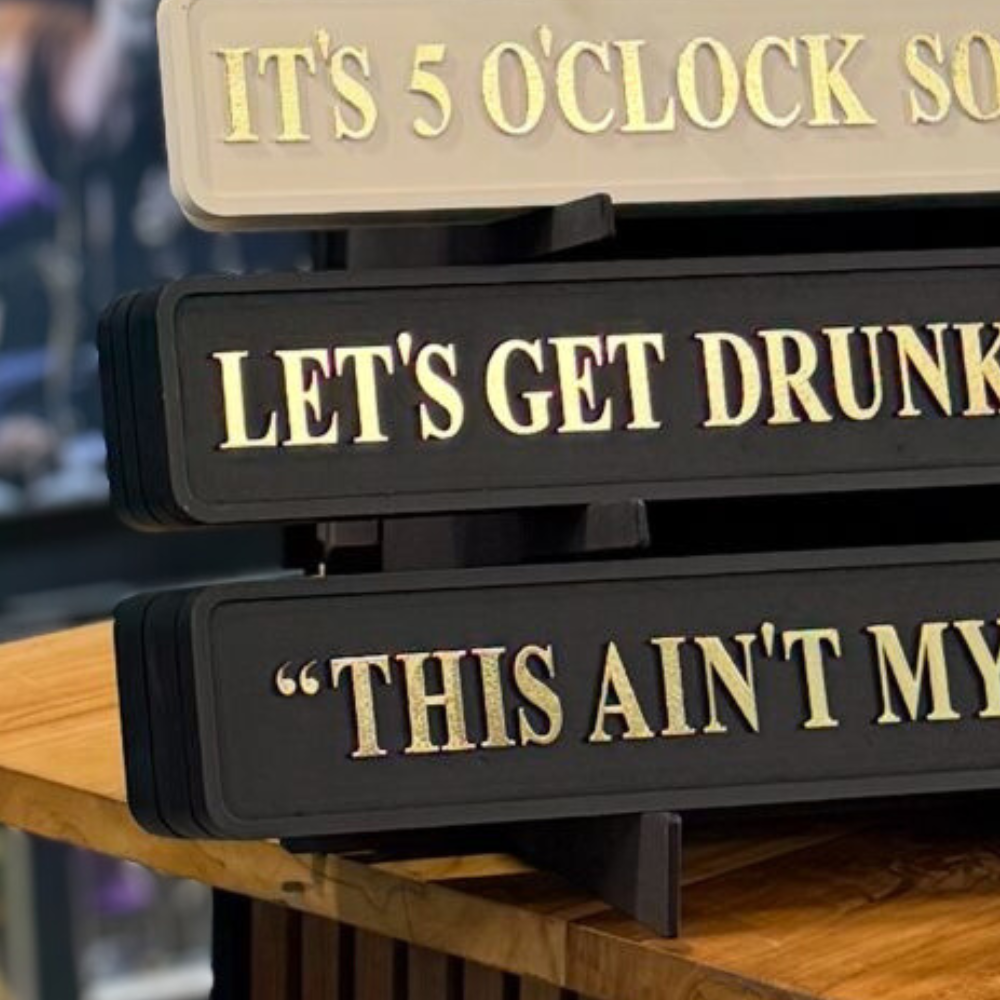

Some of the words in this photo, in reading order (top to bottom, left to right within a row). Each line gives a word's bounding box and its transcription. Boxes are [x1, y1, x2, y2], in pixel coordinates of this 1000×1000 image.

[215, 26, 379, 144] IT'S
[408, 42, 453, 137] 5
[480, 24, 876, 135] O'CLOCK
[213, 332, 465, 451] LET'S
[484, 332, 666, 435] GET
[588, 621, 843, 744] AIN'T
